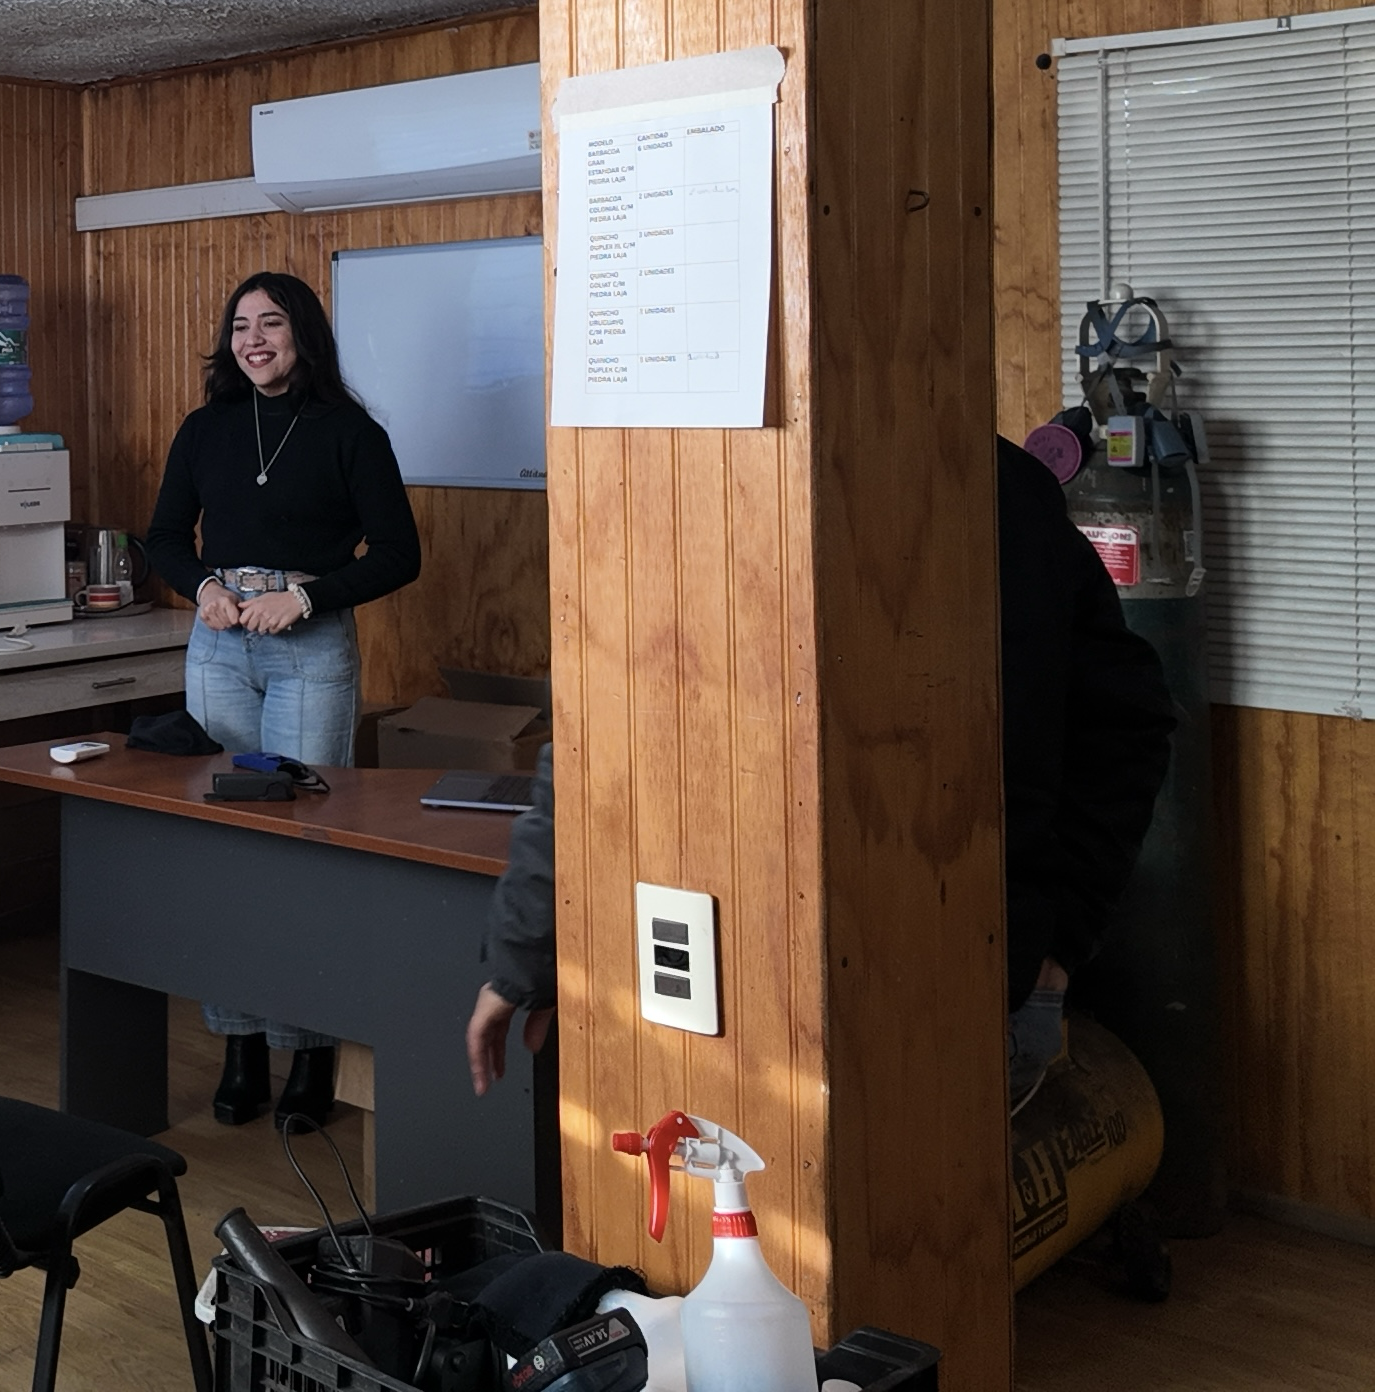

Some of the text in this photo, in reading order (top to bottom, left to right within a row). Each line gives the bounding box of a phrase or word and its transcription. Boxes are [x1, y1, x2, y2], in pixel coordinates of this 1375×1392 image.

[686, 124, 726, 136] EMBALADO
[637, 131, 669, 142] CANTIDAD
[588, 138, 614, 148] MODELO
[643, 141, 673, 151] UNIDADES
[588, 148, 621, 158] BARBACOA
[588, 167, 620, 176] ESTANDAR
[588, 175, 626, 186] PIEDRA LAJA
[643, 189, 674, 199] UNIDADES
[589, 195, 622, 205] BARBACOA
[589, 205, 620, 214] COLONIAL
[589, 213, 627, 223] PIEDRA LAJA
[589, 233, 619, 243] QUINCHO
[643, 228, 674, 239] UNIDADES
[589, 251, 627, 261] PIEDRA LAJA
[589, 271, 619, 281] QUINCHO
[644, 267, 675, 277] UNIDADES
[589, 289, 628, 298] PIEDRA LAJA
[589, 309, 619, 319] QUINCHO
[644, 306, 676, 315] UNIDADES
[603, 327, 626, 336] PIEDRA
[588, 338, 604, 346] LAJA
[588, 356, 619, 366] QUINCHO
[644, 354, 677, 364] UNIDADES
[587, 376, 628, 384] PIEDRA LAJA
